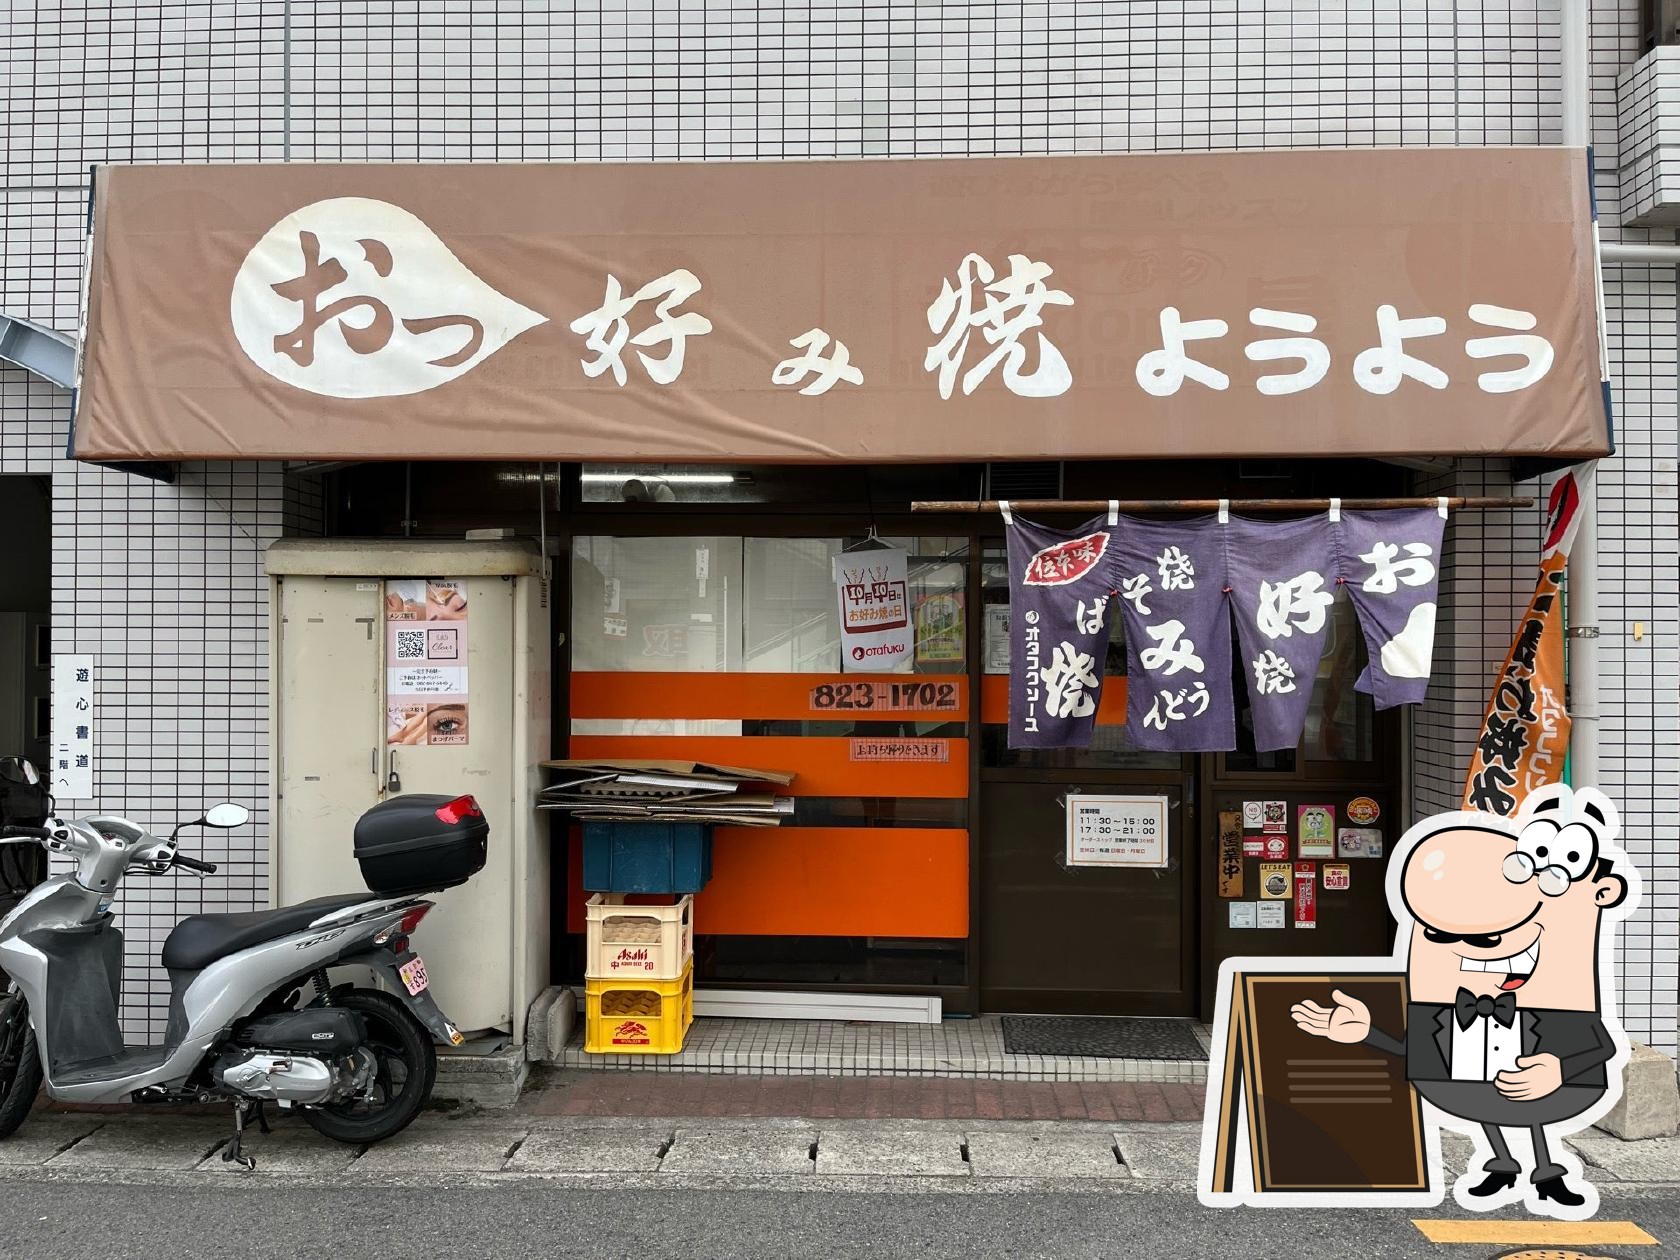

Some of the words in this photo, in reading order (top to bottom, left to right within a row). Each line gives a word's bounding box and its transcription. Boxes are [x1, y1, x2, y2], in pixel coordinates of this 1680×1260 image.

[1135, 302, 1555, 398] ようよう
[849, 605, 902, 622] お好み焼の日
[814, 683, 956, 708] 823-1702
[75, 668, 89, 768] 遊心書道
[59, 743, 69, 786] 二階へ
[611, 961, 620, 970] 中
[644, 962, 654, 970] 20
[617, 948, 647, 960] Asahi
